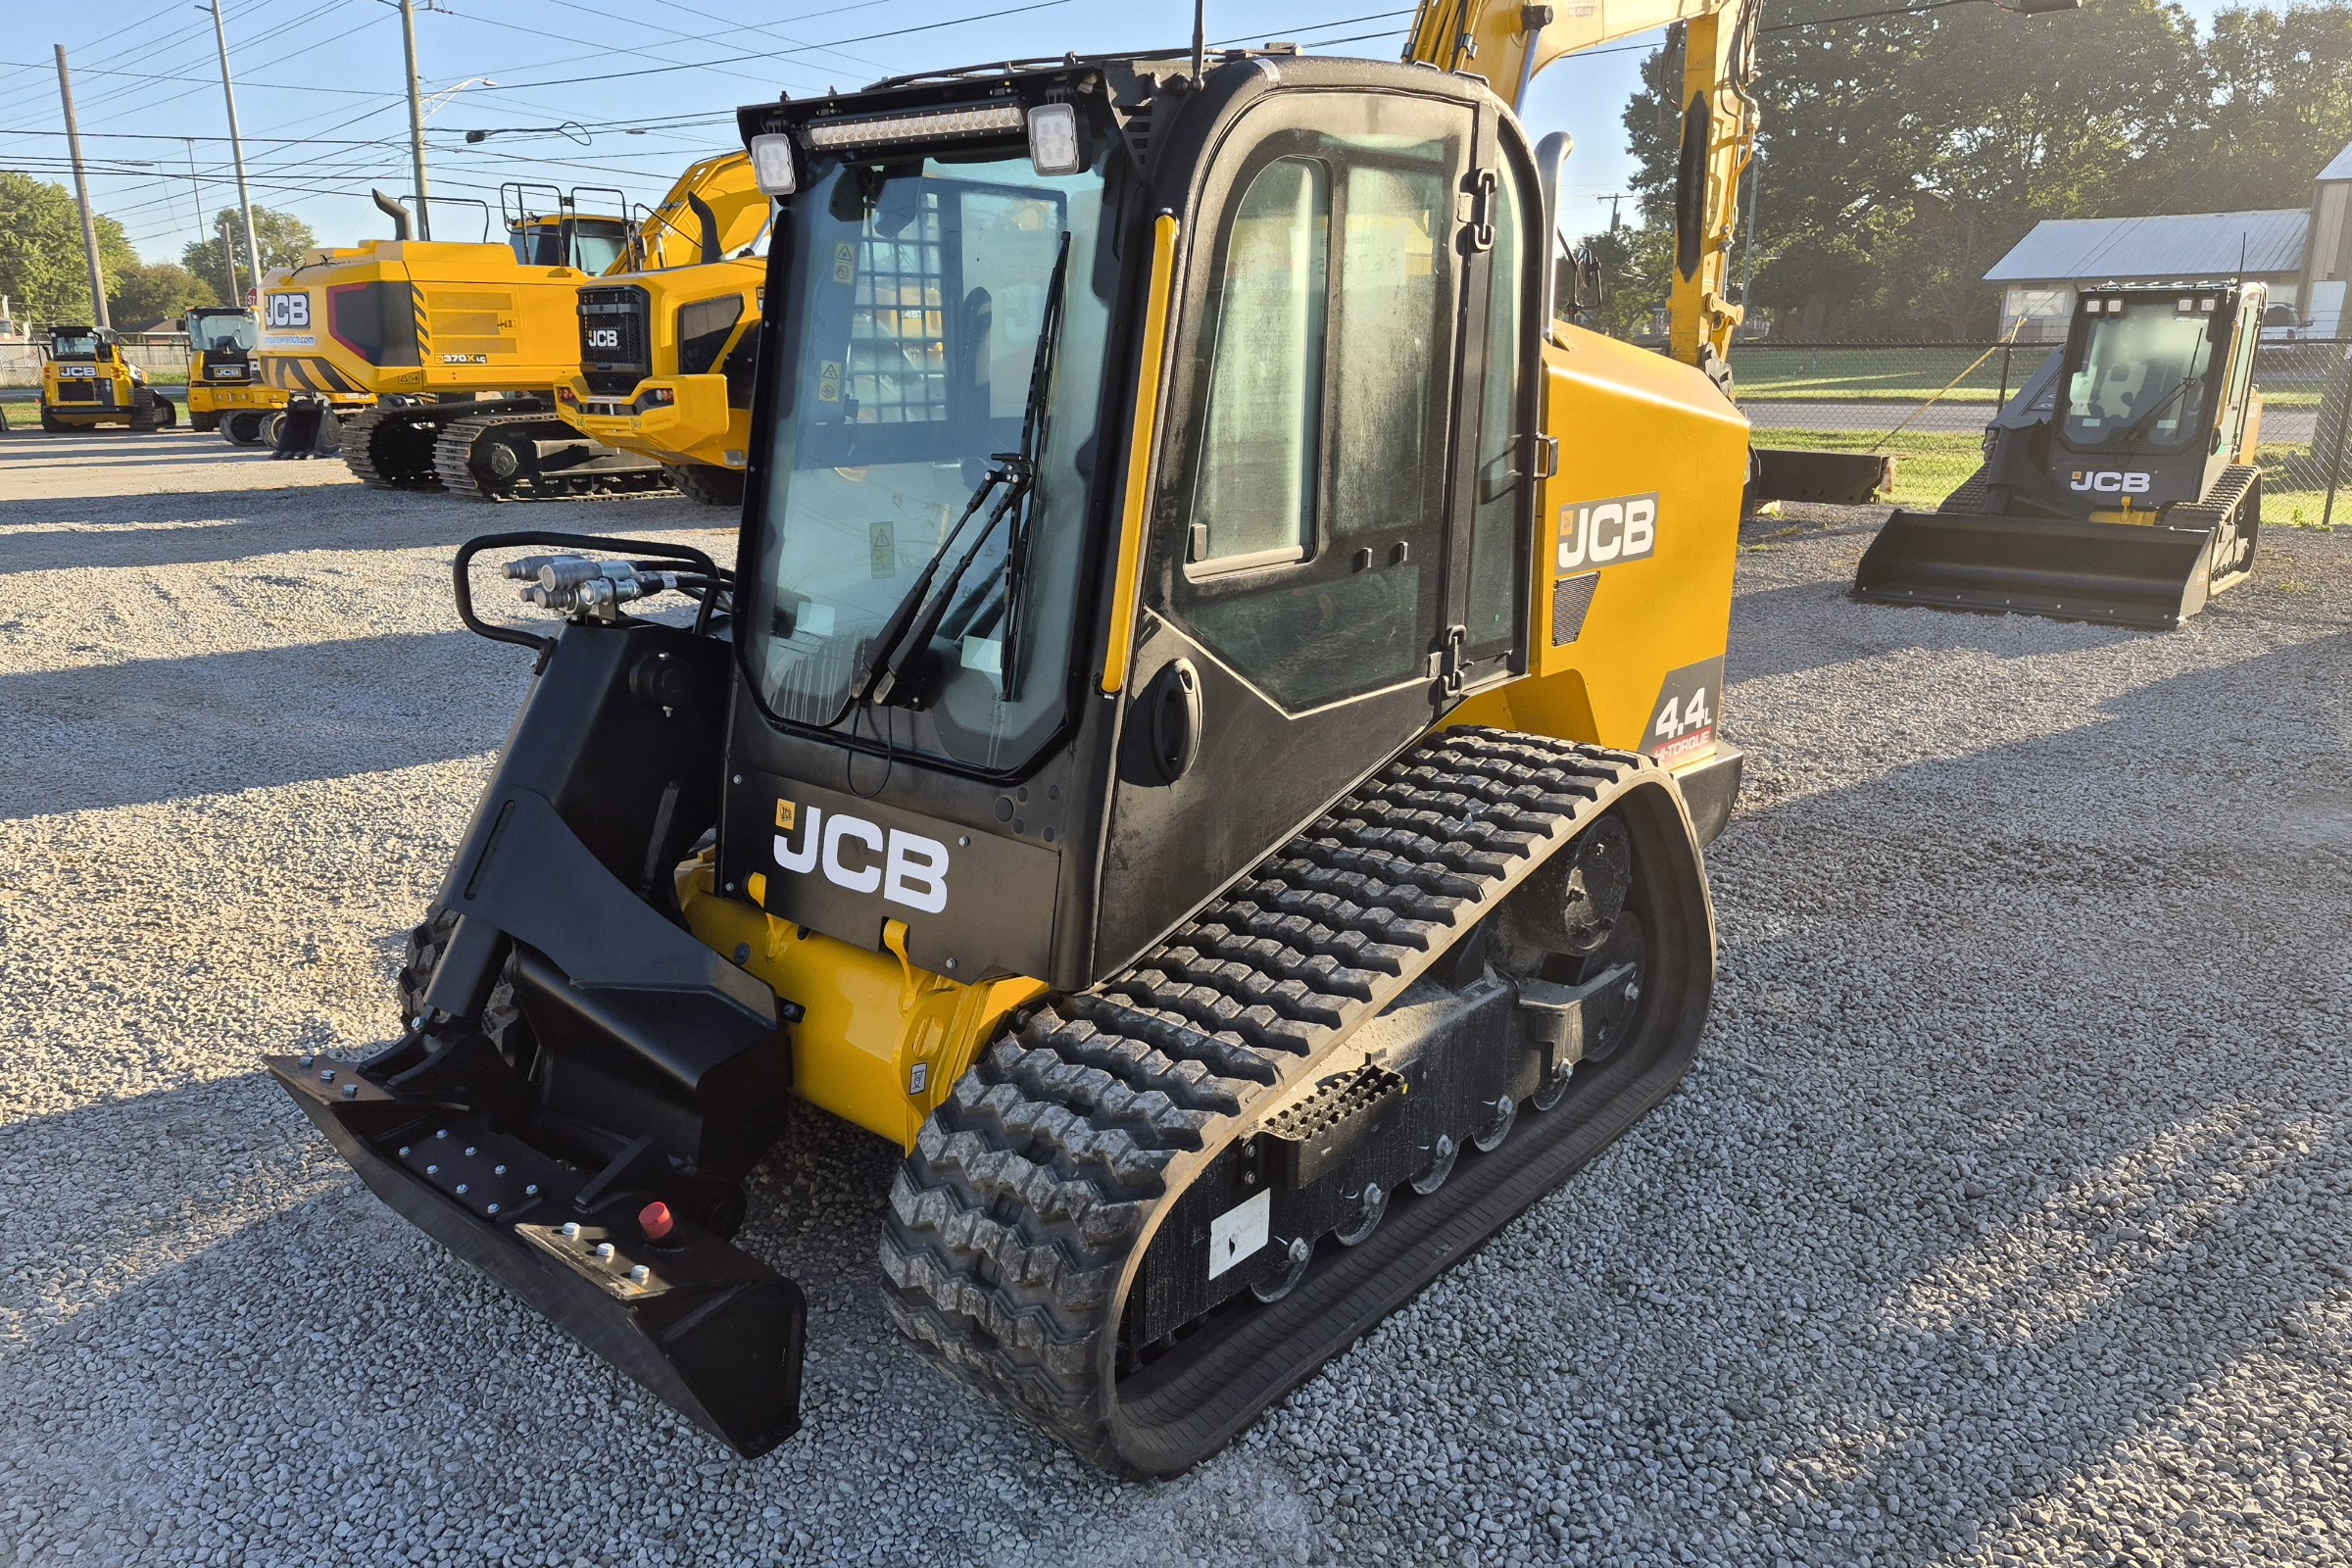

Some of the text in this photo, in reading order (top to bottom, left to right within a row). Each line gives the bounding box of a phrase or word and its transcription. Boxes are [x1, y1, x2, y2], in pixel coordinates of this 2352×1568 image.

[266, 294, 309, 326] JCB
[589, 330, 617, 347] JCB
[61, 367, 96, 376] JCB
[2070, 471, 2150, 492] JCB
[1557, 498, 1655, 568] JCB
[1654, 730, 1710, 761] HI-TORQUE
[773, 806, 950, 913] JCB
